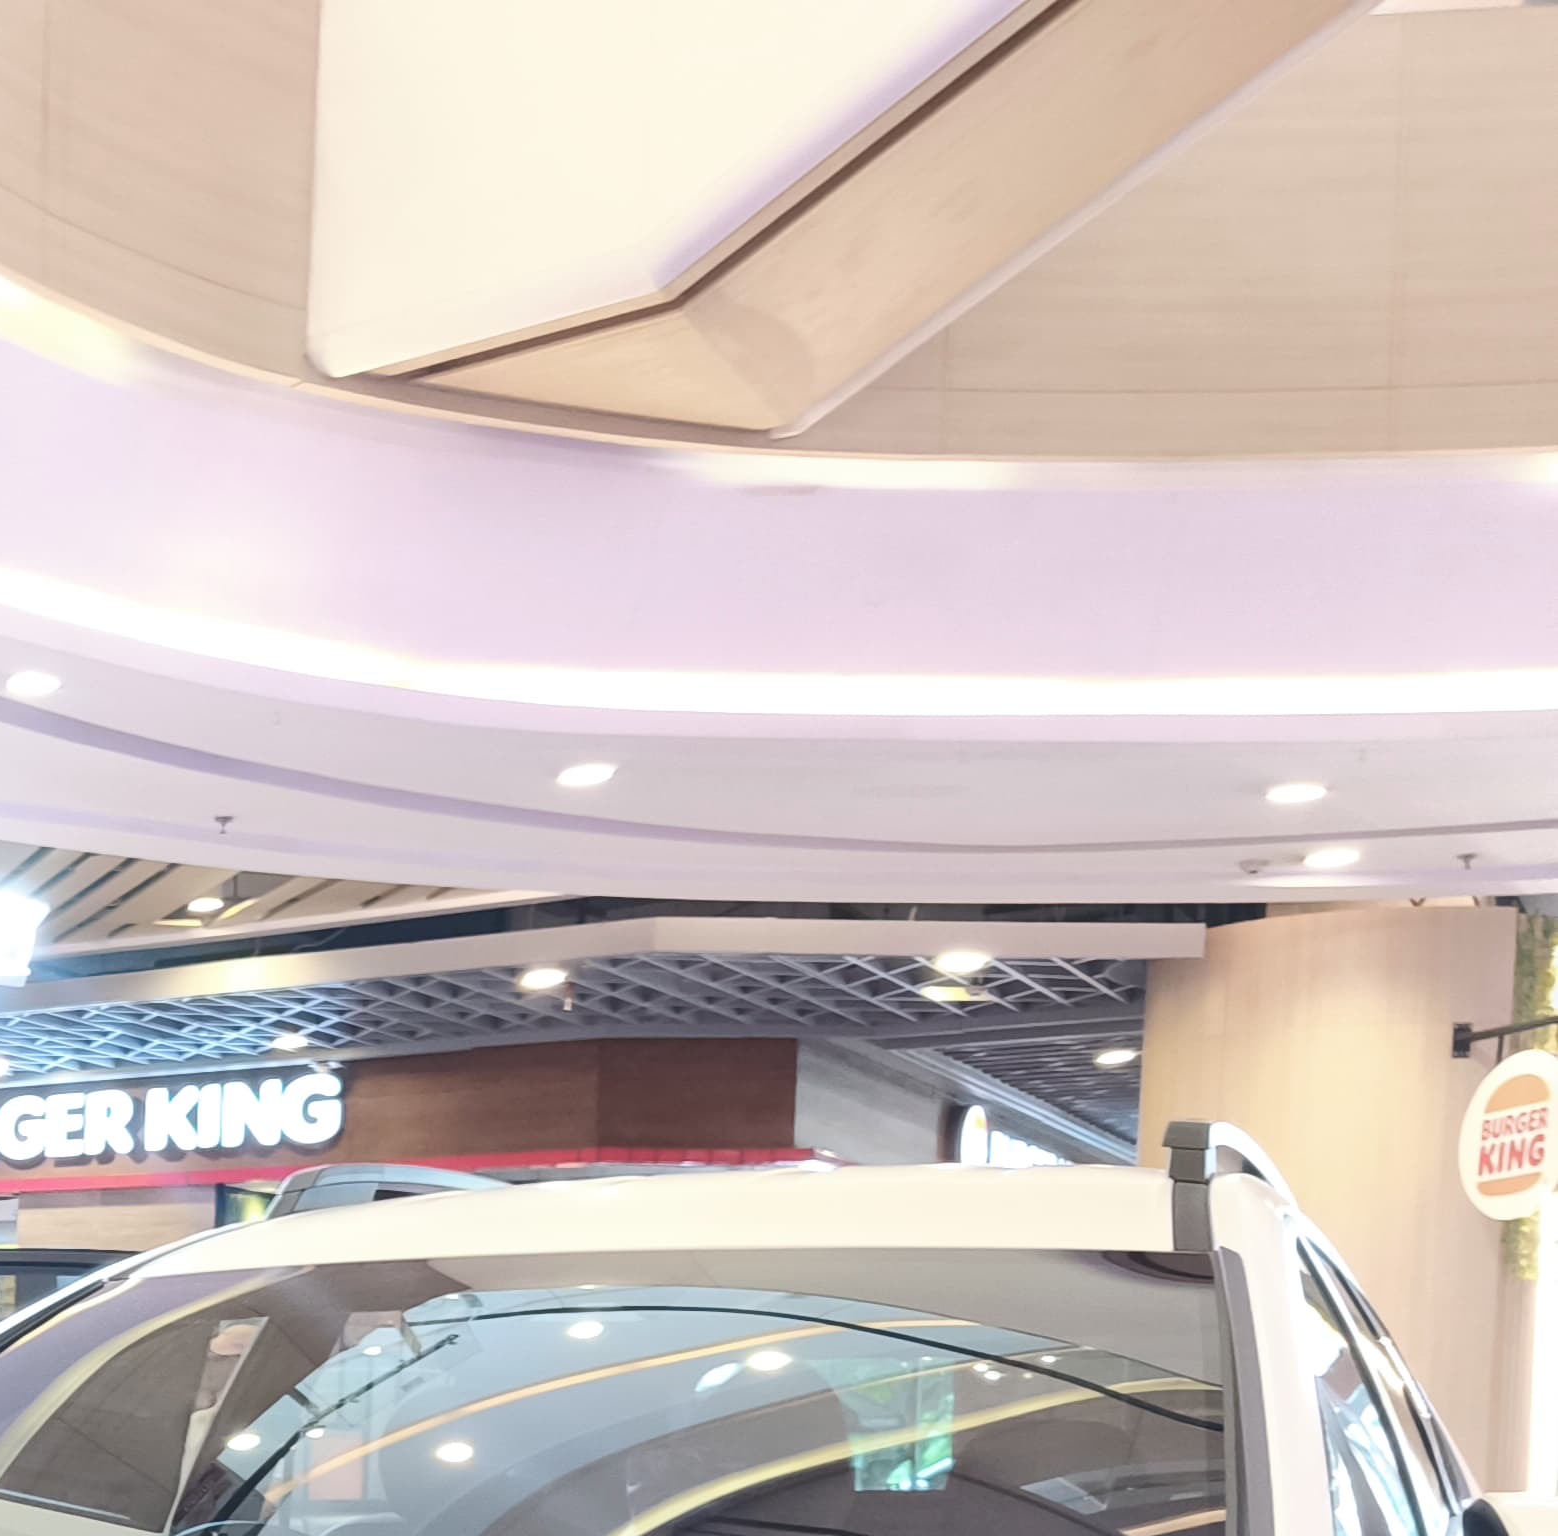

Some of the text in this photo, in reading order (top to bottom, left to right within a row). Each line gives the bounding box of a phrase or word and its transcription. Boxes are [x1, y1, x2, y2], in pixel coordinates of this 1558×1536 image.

[144, 1073, 343, 1152] KING
[1481, 1107, 1548, 1141] BURGER
[1478, 1134, 1545, 1176] KING
